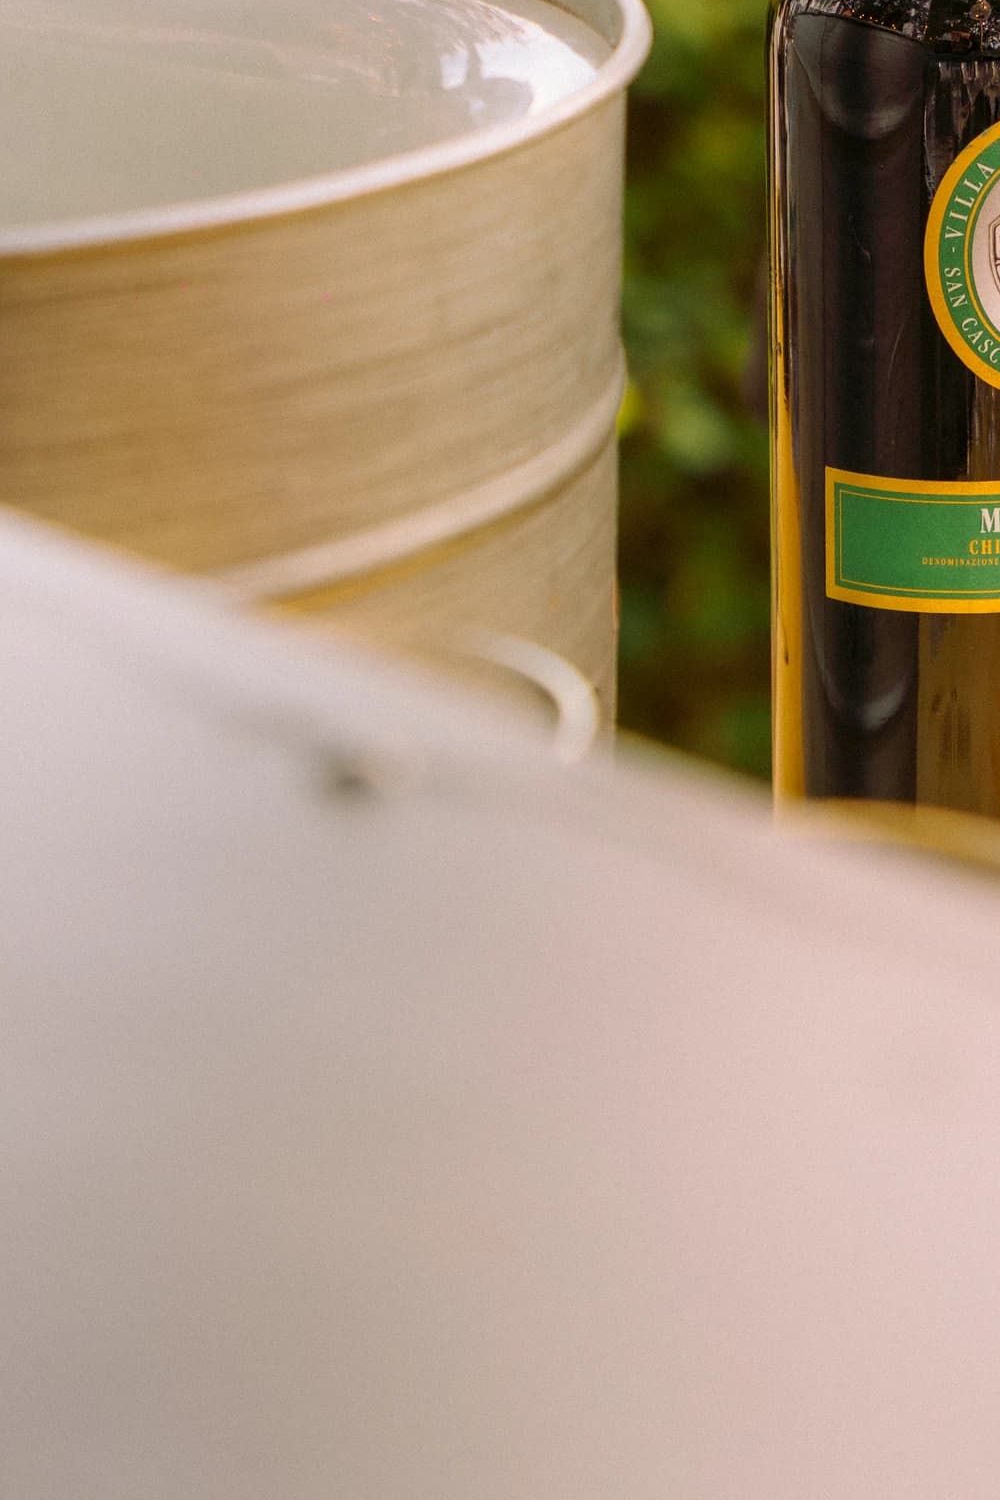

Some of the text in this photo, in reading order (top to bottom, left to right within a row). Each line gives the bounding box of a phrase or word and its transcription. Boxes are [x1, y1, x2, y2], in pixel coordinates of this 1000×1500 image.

[944, 163, 995, 239] VILLA
[944, 266, 968, 309] SAN
[922, 556, 999, 567] DENOMINAZIONE
